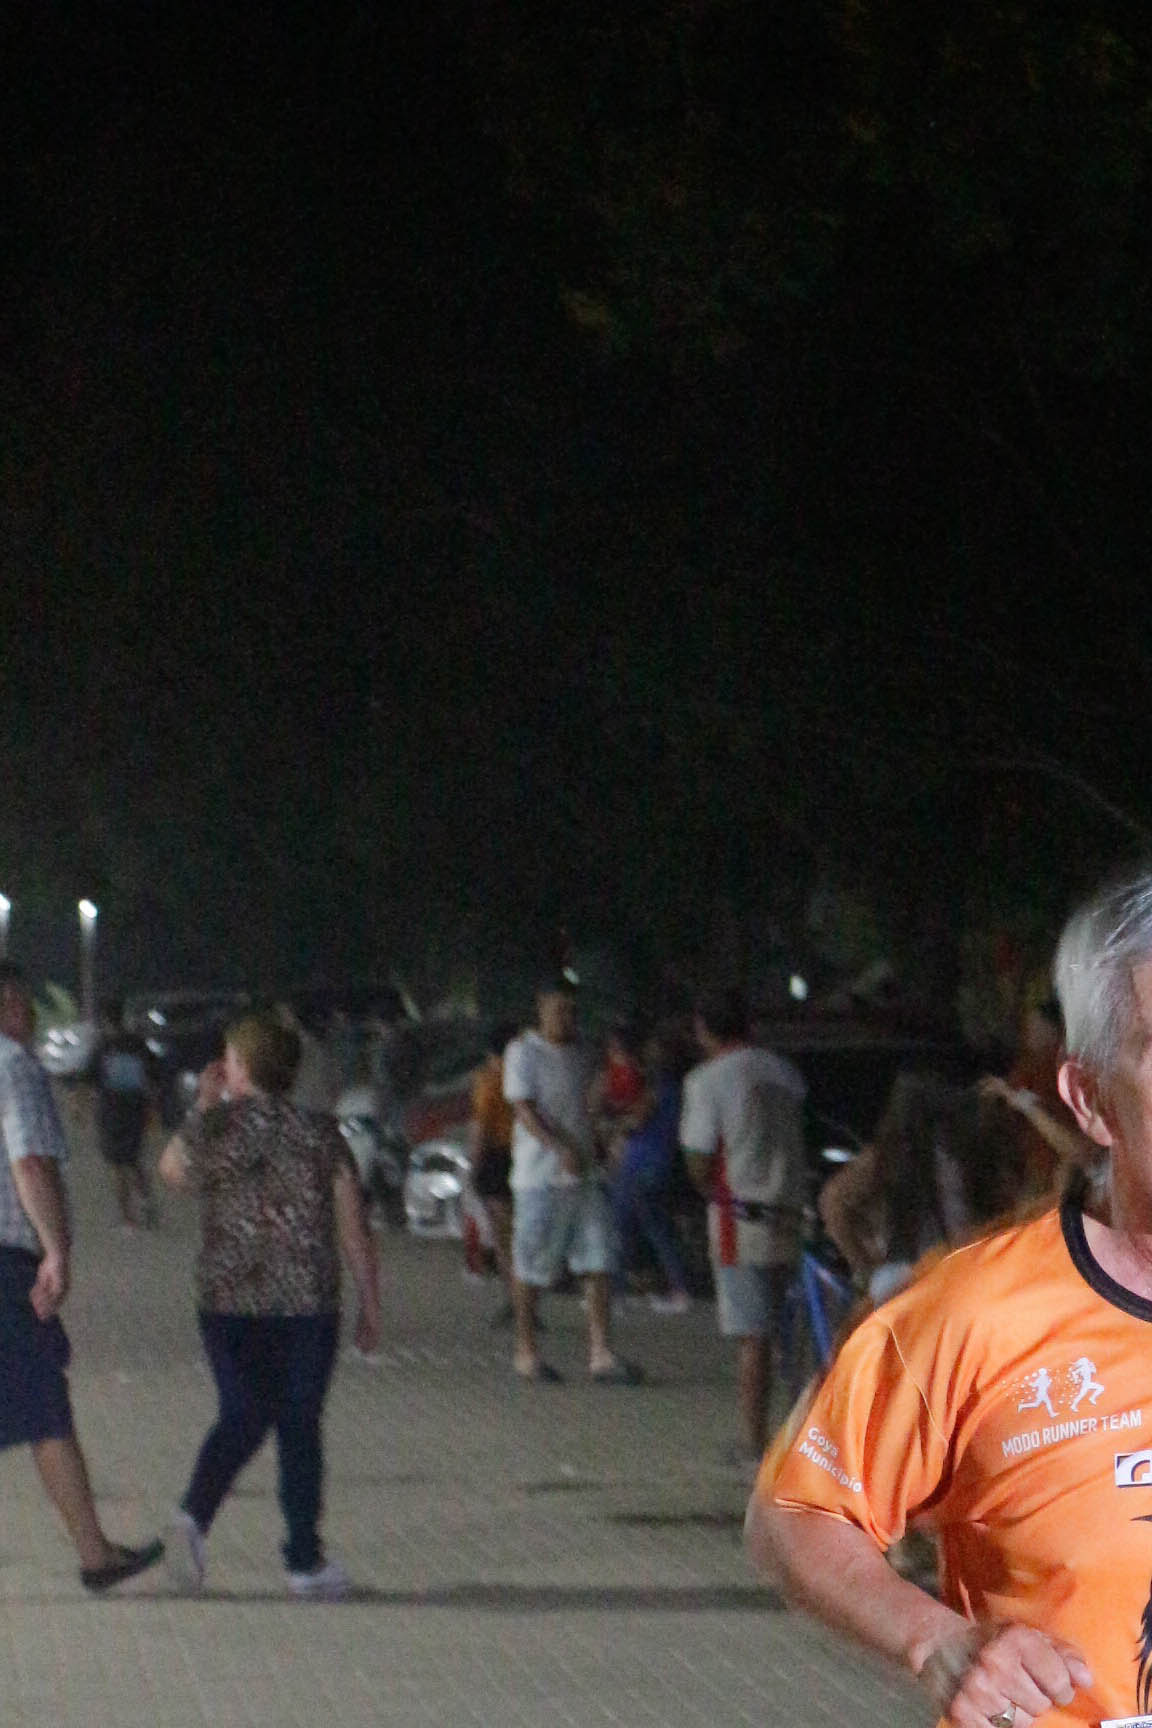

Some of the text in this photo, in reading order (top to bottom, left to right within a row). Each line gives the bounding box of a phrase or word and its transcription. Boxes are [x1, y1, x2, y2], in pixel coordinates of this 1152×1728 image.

[1002, 1408, 1142, 1458] MODO RUNNER TEAM
